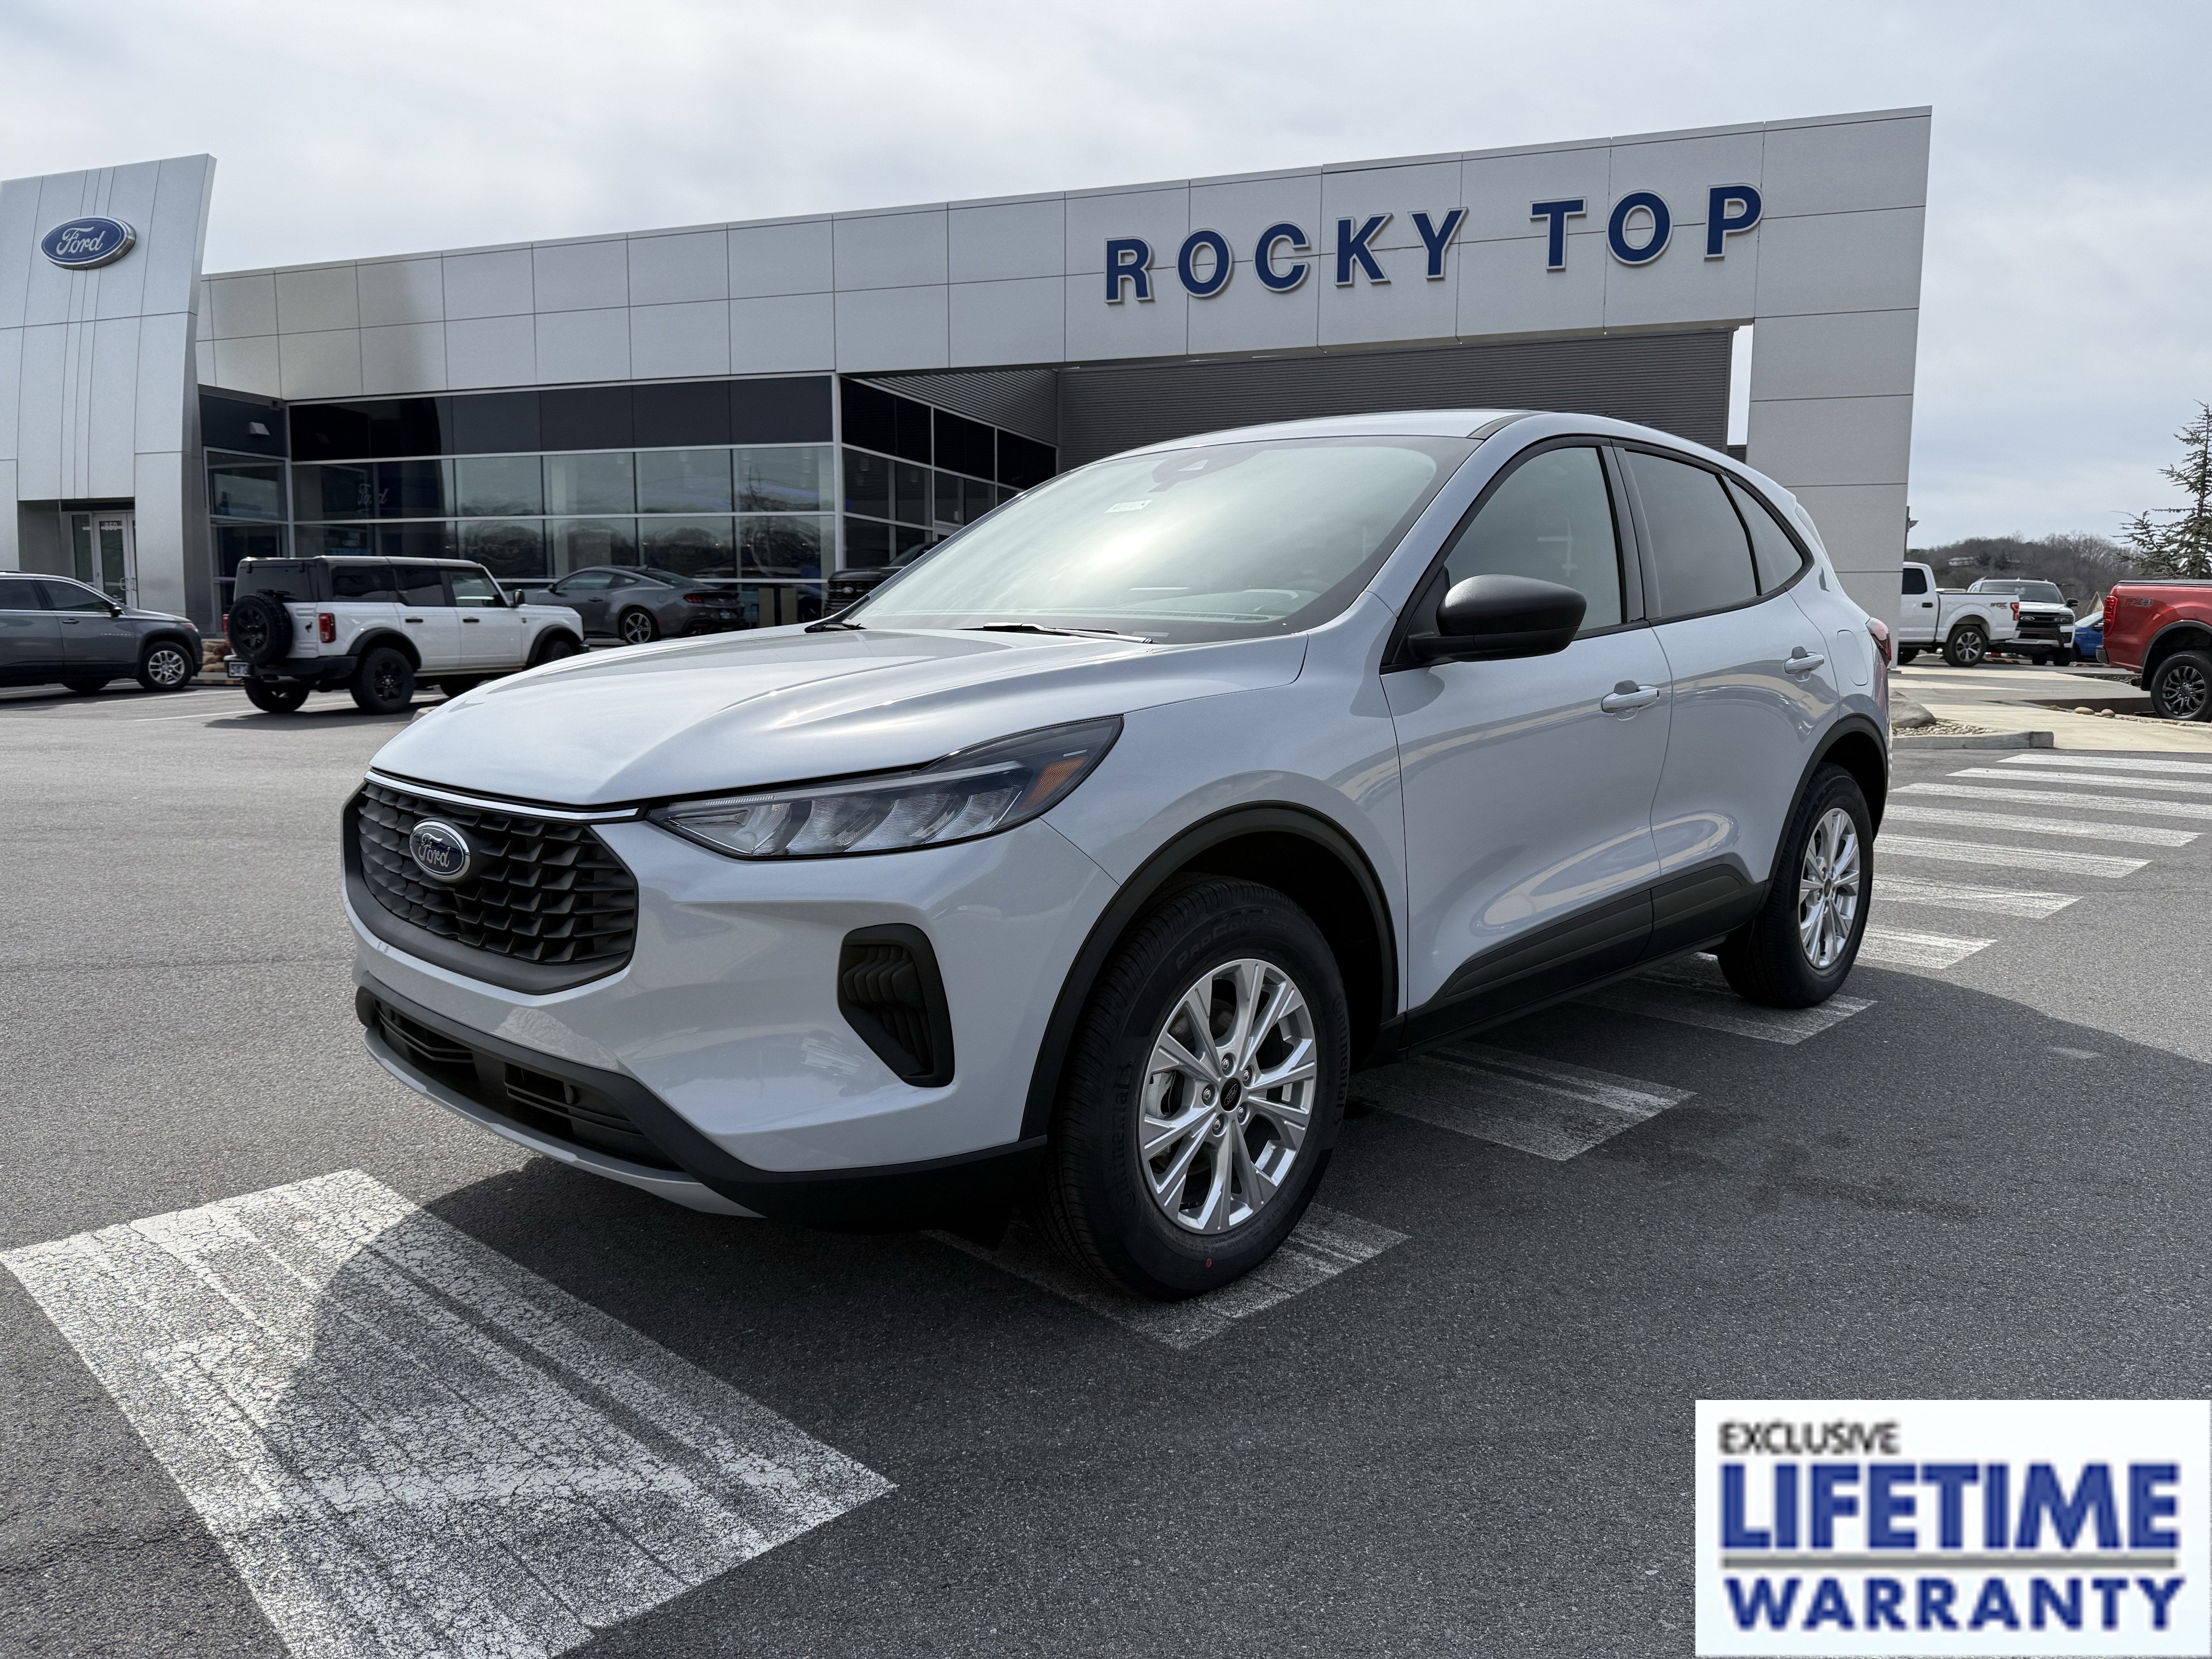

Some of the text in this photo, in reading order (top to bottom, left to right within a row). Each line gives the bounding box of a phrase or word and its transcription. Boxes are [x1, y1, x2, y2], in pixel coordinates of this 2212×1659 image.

[56, 226, 106, 255] Ford
[1105, 184, 1763, 302] ROCKY TOP
[357, 483, 389, 505] Fod
[418, 833, 450, 867] Ford
